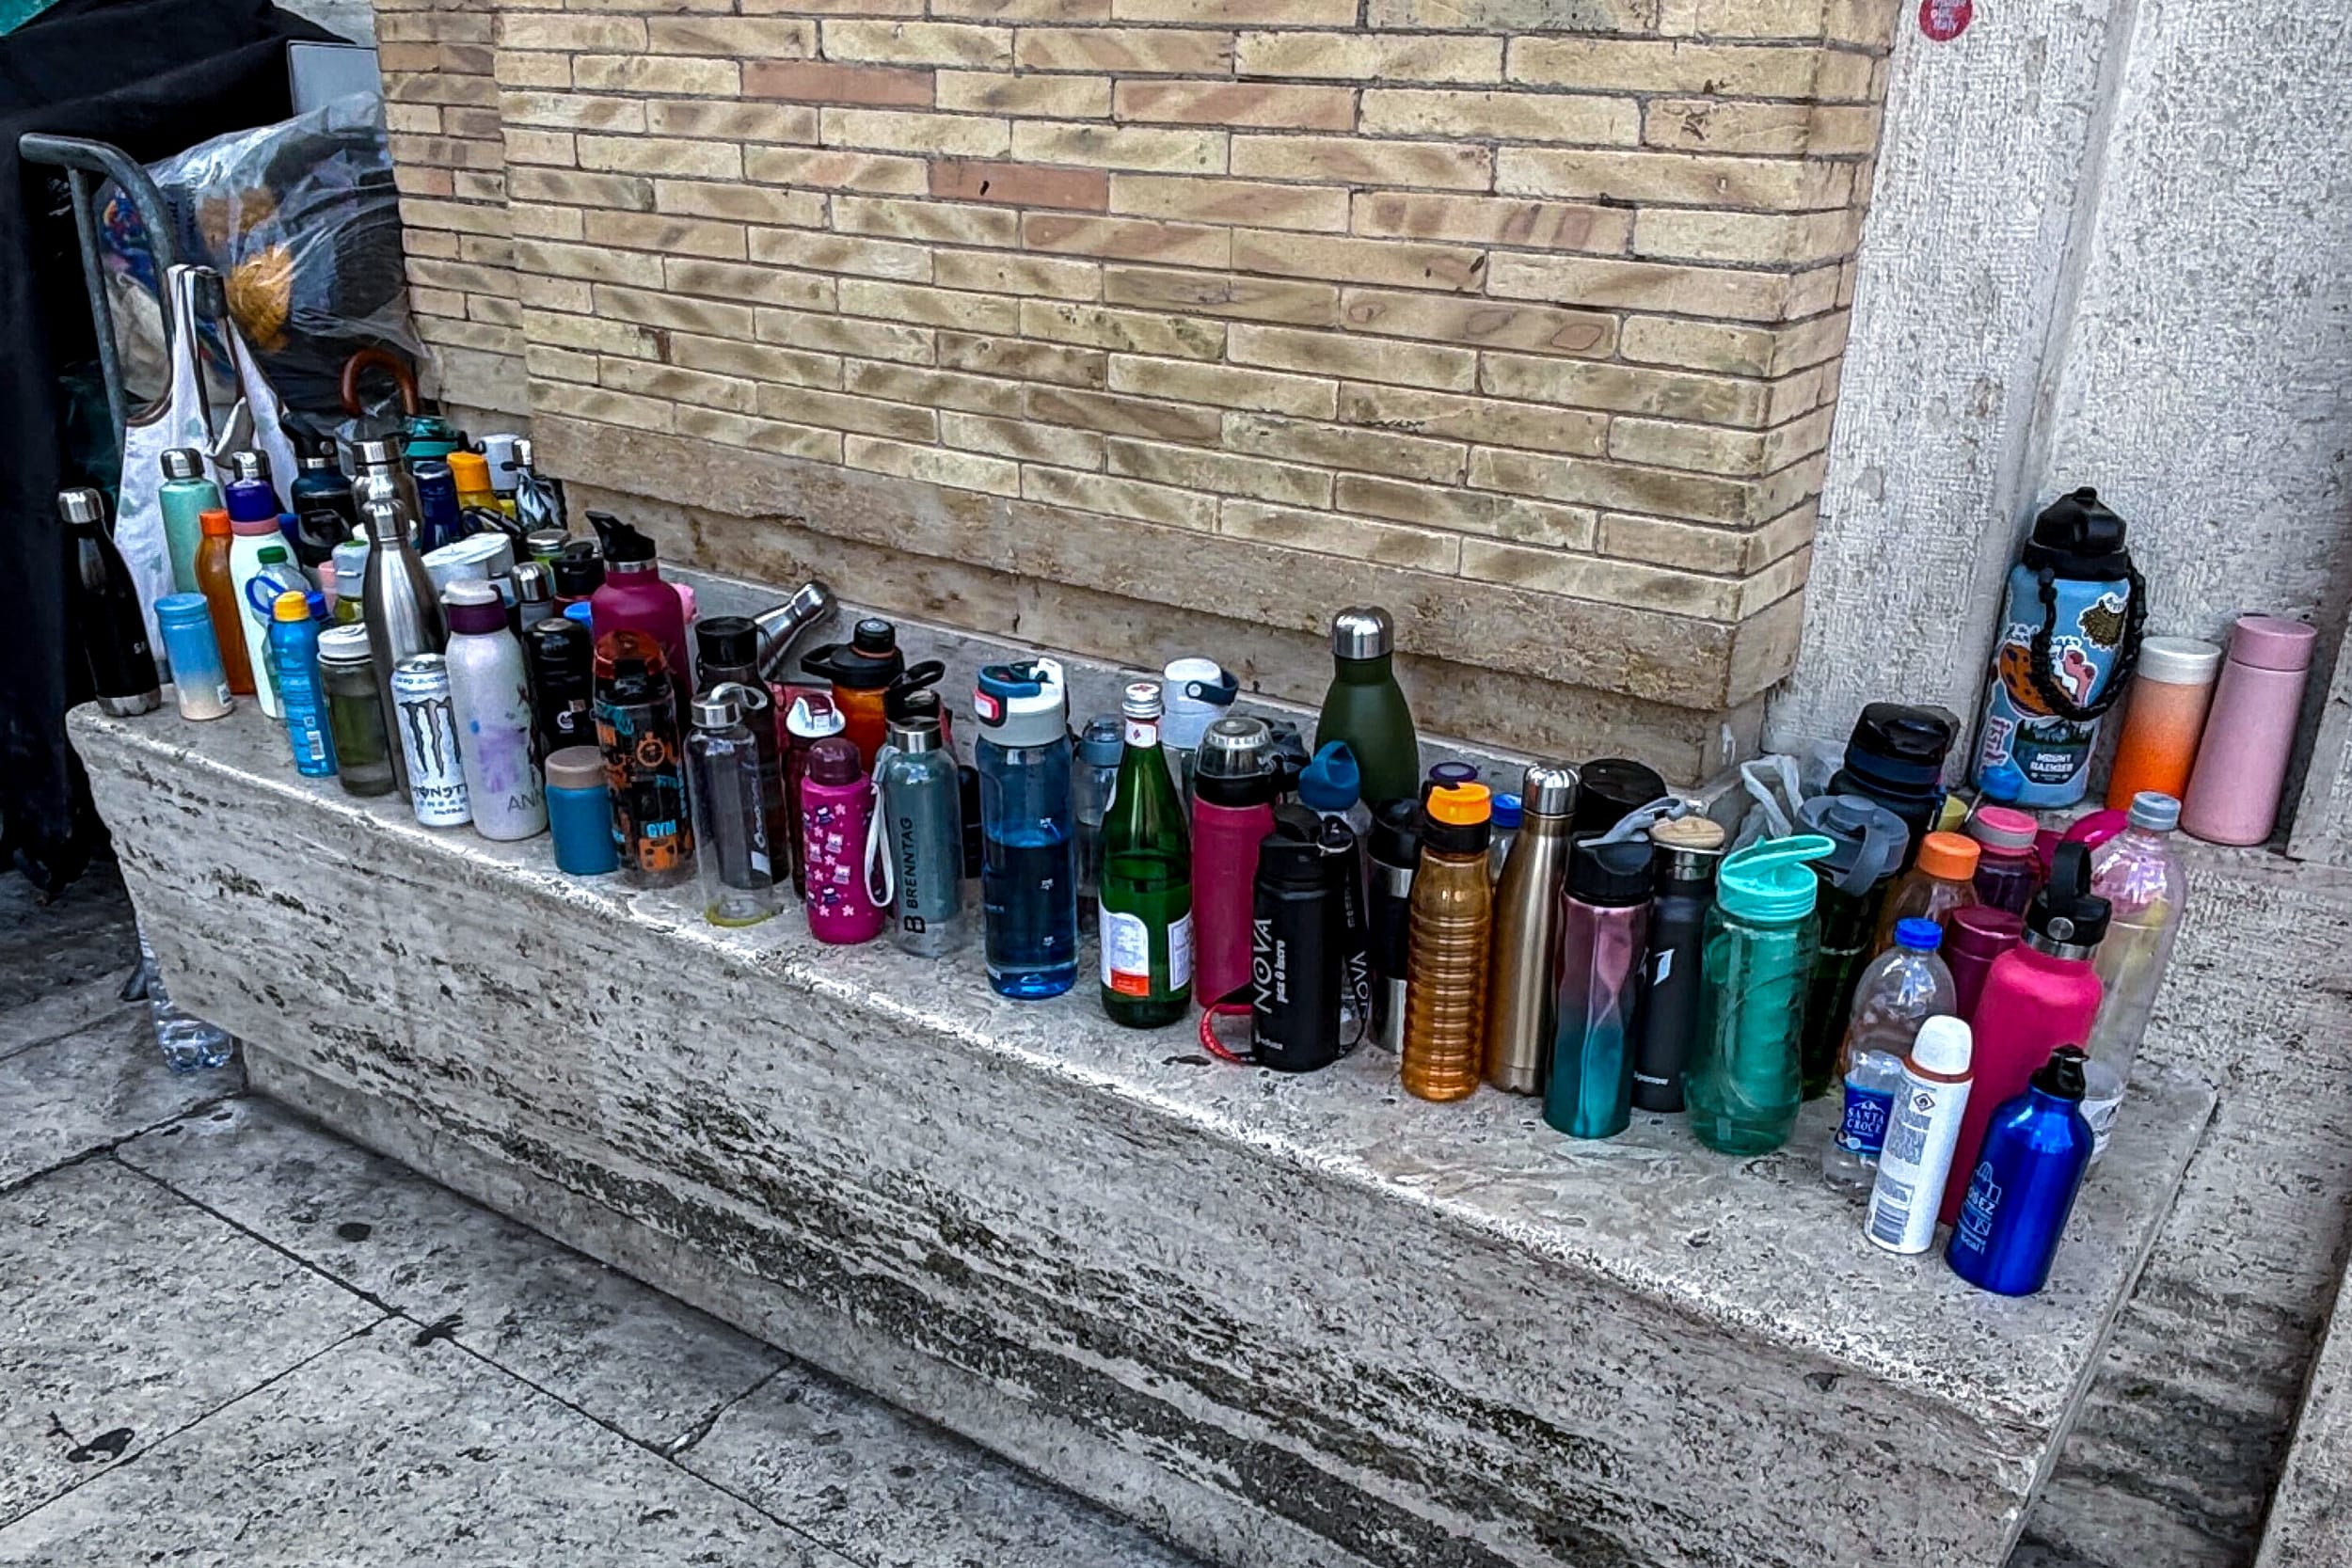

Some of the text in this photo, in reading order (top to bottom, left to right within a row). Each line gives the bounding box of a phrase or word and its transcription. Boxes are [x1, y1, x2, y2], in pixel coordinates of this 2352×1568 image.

[645, 818, 677, 839] GYM
[899, 816, 919, 910] BRENNTAG
[1252, 918, 1273, 1015] NOVA
[1846, 1107, 1885, 1126] SANTA
[1846, 1117, 1882, 1134] CROCE
